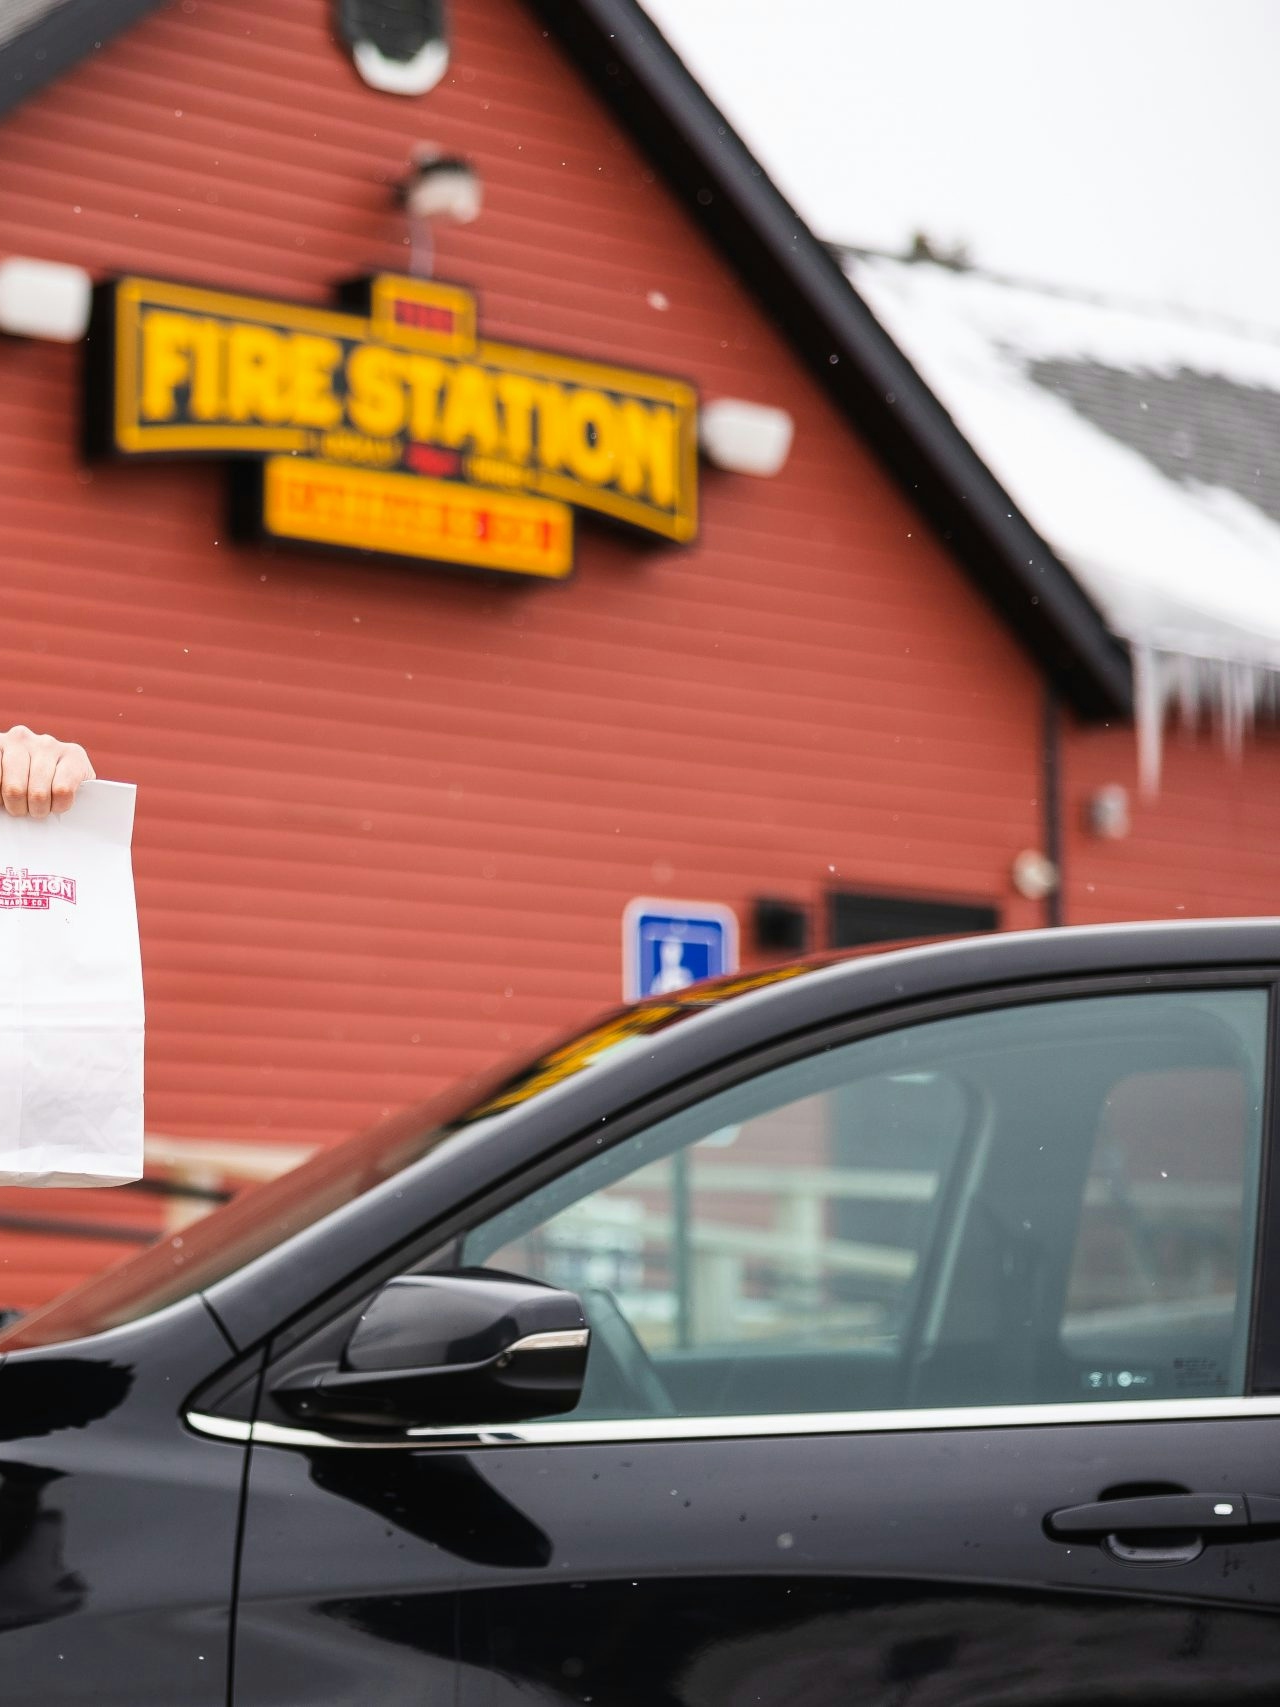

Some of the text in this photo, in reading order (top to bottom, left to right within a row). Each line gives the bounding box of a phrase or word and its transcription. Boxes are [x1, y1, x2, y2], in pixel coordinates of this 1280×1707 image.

[142, 308, 676, 508] FIRE STATION
[1, 877, 71, 897] STATION
